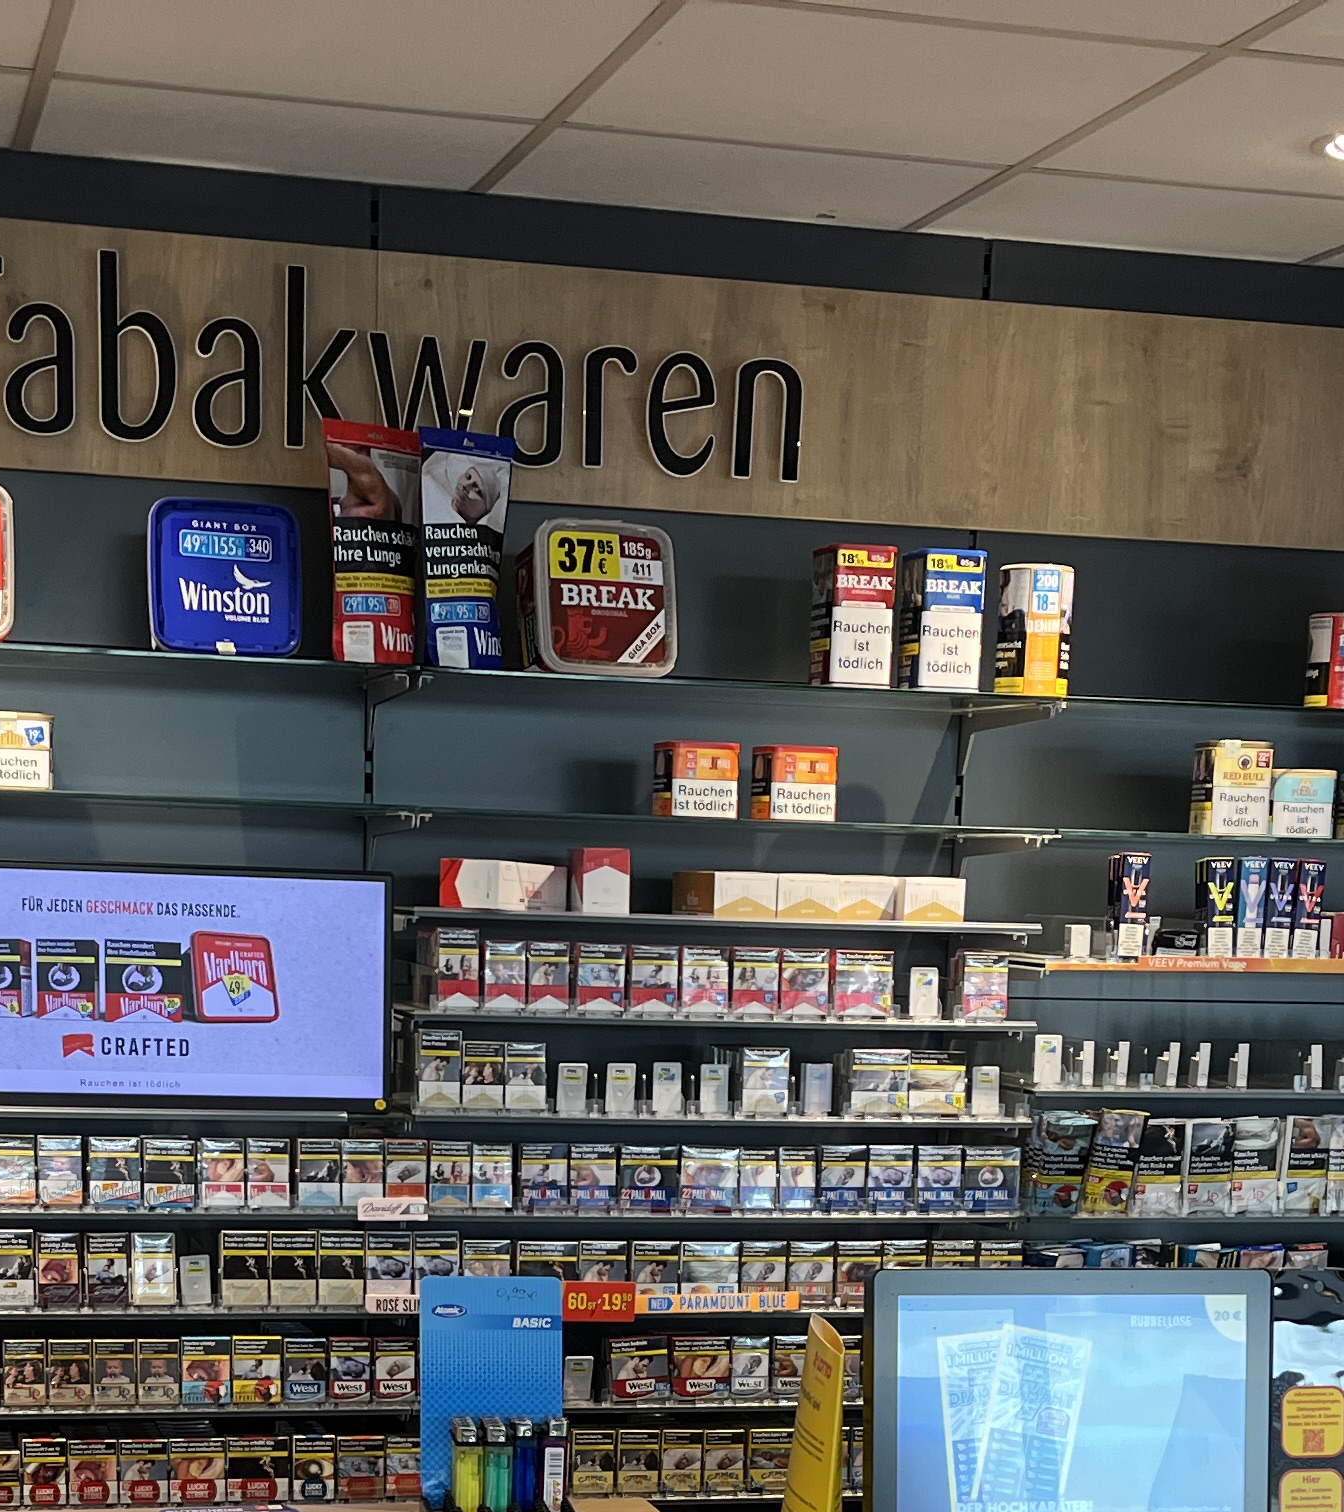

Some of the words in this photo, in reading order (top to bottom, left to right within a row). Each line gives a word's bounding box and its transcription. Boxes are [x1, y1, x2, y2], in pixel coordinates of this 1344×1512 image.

[191, 519, 228, 531] GIANT
[234, 523, 258, 533] BOX
[333, 547, 364, 563] Ihre
[367, 548, 402, 566] Lunge
[425, 542, 488, 559] verursacht
[556, 538, 594, 574] 37
[632, 562, 653, 577] 411
[836, 573, 894, 591] BREAK
[925, 577, 982, 596] BREAK
[178, 577, 271, 616] Winston
[560, 582, 656, 612] BREAK
[833, 620, 892, 637] Rauchen
[627, 639, 648, 661] GIGA
[643, 621, 663, 643] BOX
[853, 639, 870, 652] ist
[838, 654, 884, 671] tödlich
[1222, 771, 1242, 781] RED
[1243, 771, 1265, 781] BULL
[678, 784, 734, 799] Rauchen
[674, 800, 690, 812] ist
[693, 798, 735, 815] tödlich
[21, 896, 44, 913] FÜR
[46, 899, 83, 914] JEDEN
[86, 900, 154, 917] GESCHMACK
[156, 902, 179, 917] DAS
[181, 902, 241, 919] PASSENDE.
[1147, 957, 1173, 970] VEEV
[1175, 957, 1215, 970] Premium
[1217, 959, 1247, 972] Vape
[101, 1036, 190, 1057] CRAFTED
[79, 1078, 125, 1089] Rauchen
[146, 1078, 182, 1090] tödlich
[567, 1292, 587, 1310] 60
[650, 1298, 668, 1311] NEU
[679, 1294, 751, 1310] PARAMOUNT
[758, 1293, 787, 1309] BLUE
[512, 1317, 552, 1329] BASIC
[1130, 1315, 1194, 1329] RUBBELLOSE
